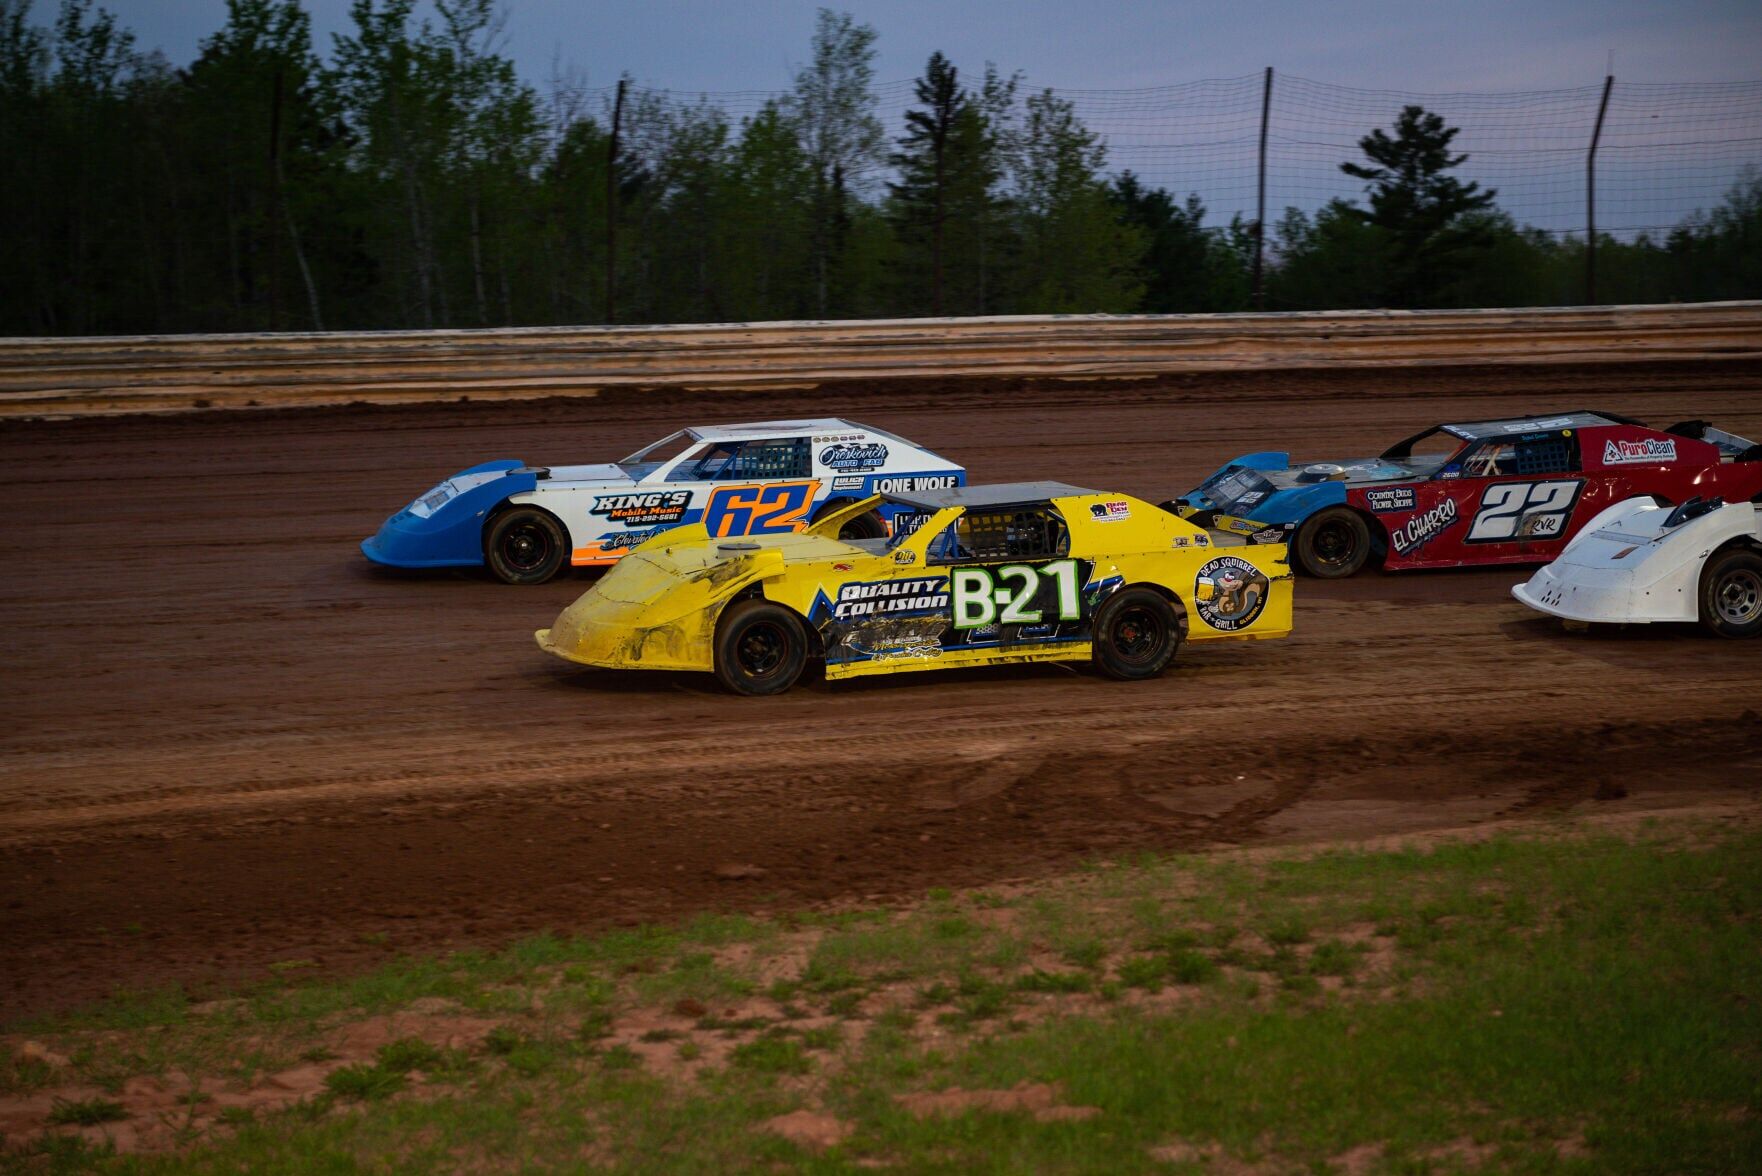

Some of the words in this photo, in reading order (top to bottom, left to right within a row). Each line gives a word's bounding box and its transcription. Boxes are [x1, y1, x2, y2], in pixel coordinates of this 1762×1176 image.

[819, 444, 888, 464] Oreskovich
[1620, 441, 1674, 456] PuroClean
[832, 459, 858, 467] AUTO
[862, 458, 883, 466] FAB
[873, 478, 912, 494] LONE
[914, 476, 957, 491] WOLF
[595, 492, 689, 511] KING'S
[703, 483, 814, 538] 62
[1468, 481, 1580, 540] 22
[611, 508, 647, 518] Mobile
[649, 507, 683, 515] Music
[1392, 529, 1409, 552] EL
[1407, 498, 1456, 542] CHARRO
[1532, 518, 1556, 532] RVR
[1200, 561, 1219, 577] DEAD
[1220, 558, 1258, 577] SQUIRREL
[841, 579, 940, 601] QUALITY
[953, 558, 1081, 630] B-21
[834, 595, 949, 618] COLLISION
[1214, 618, 1238, 630] GRILL
